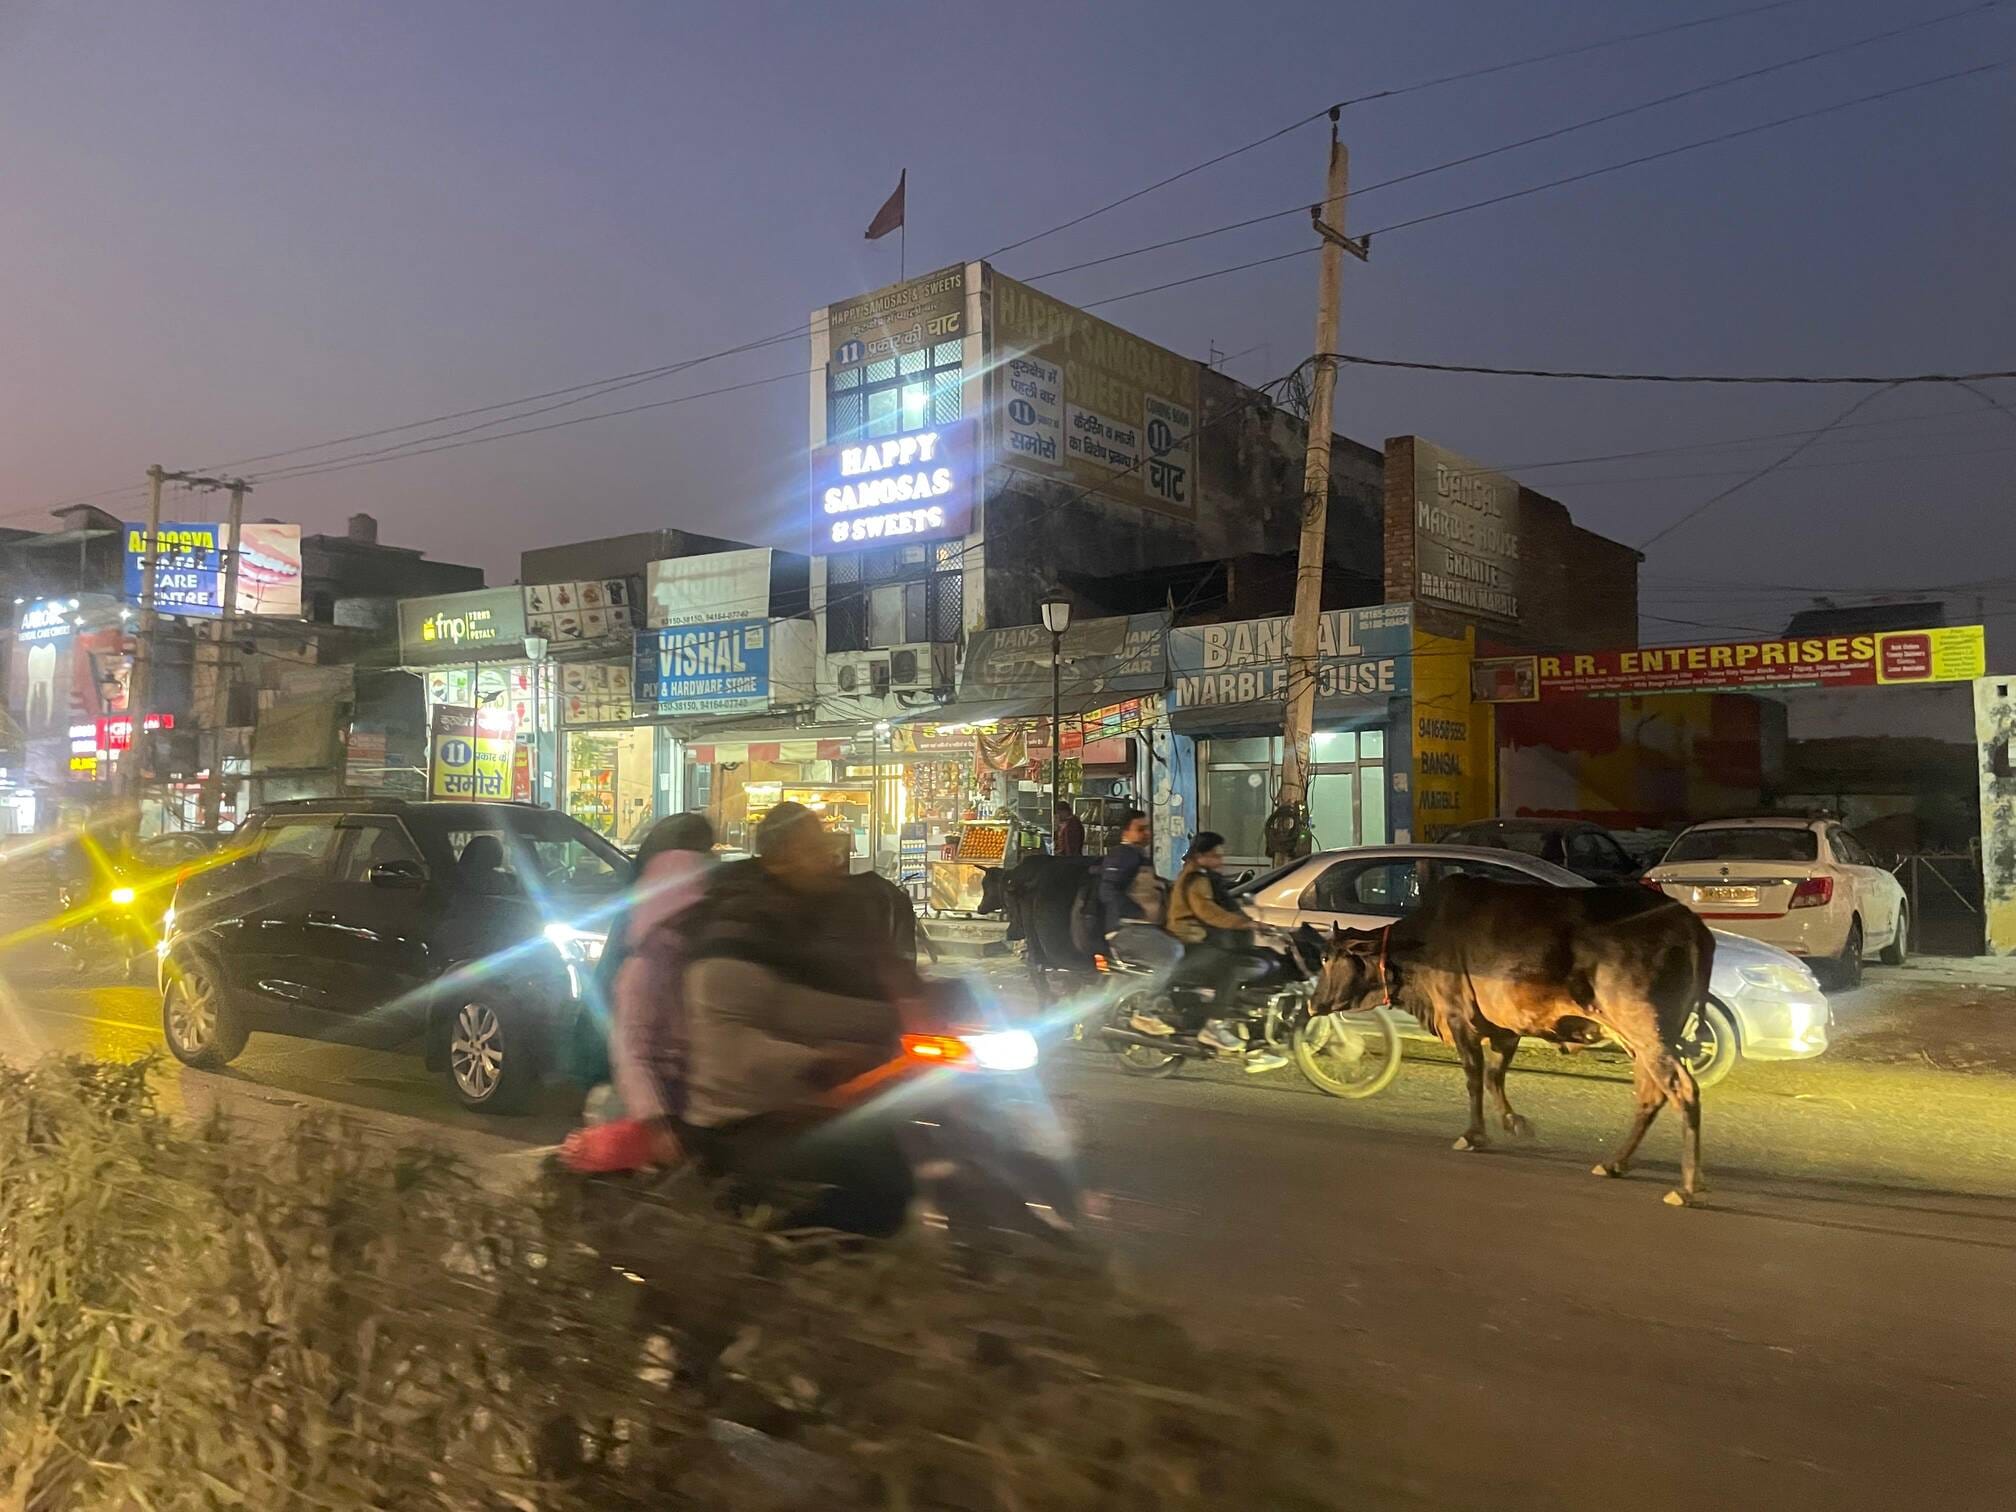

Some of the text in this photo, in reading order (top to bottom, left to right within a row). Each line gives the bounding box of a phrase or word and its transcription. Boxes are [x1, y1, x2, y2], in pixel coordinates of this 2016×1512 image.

[831, 307, 861, 327] HAPPY
[863, 291, 909, 316] SAMOSAS
[925, 274, 961, 297] SWEETS
[999, 287, 1075, 353] HAPPY
[840, 342, 859, 365] 11
[928, 311, 961, 336] चाट
[1011, 379, 1038, 399] पहली
[840, 432, 940, 476] HAPPY
[1010, 430, 1057, 461] समोसे
[824, 468, 952, 514] SAMOSAS
[1149, 457, 1187, 503] चाट
[1437, 463, 1503, 519] BANSAL
[851, 506, 944, 541] SWEETS
[1418, 500, 1475, 546] MARBLE
[435, 612, 466, 645] fnp
[994, 628, 1040, 649] HANS
[659, 630, 746, 677] VISHAL
[1540, 655, 1607, 677] R.R.
[1620, 636, 1875, 673] ENTERPRISES
[660, 681, 668, 697] &
[671, 678, 723, 697] HARDWARE
[725, 676, 758, 694] STORE
[1176, 659, 1395, 707] MARBLE OUSE
[447, 743, 465, 763] 11
[1421, 751, 1463, 776] BANSAL
[444, 768, 503, 795] समोसे
[1419, 790, 1461, 811] MARBLE
